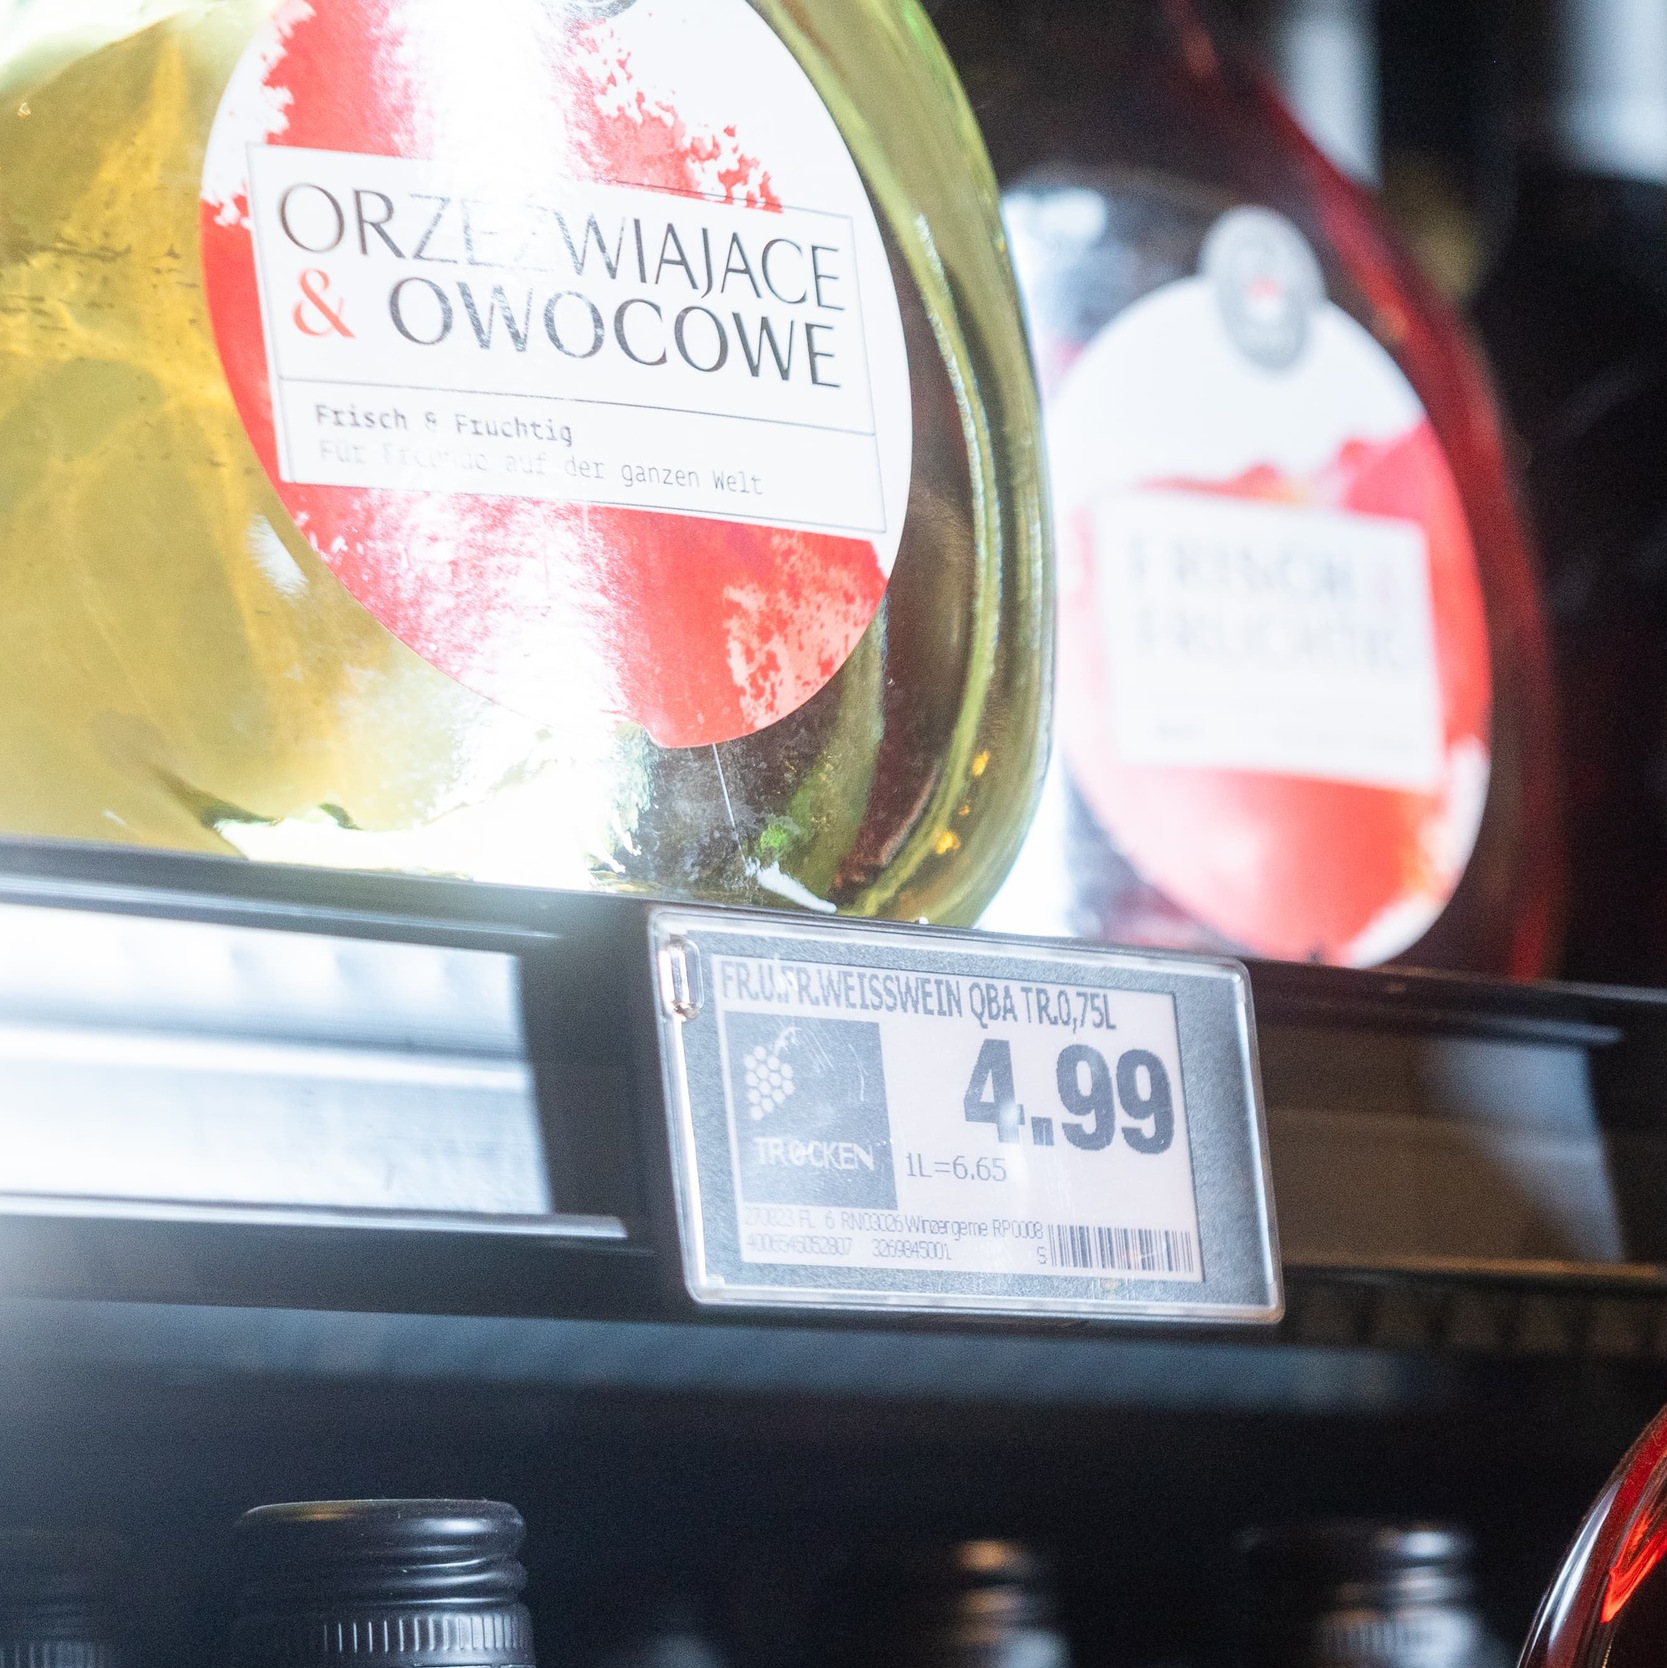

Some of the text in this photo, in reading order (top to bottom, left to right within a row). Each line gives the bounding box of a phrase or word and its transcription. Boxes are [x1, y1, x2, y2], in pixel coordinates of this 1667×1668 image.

[291, 268, 841, 388] & OWOCOWE
[315, 404, 407, 430] Frisch
[455, 414, 573, 447] Fruchtig
[504, 452, 547, 478] auf
[563, 455, 604, 481] der
[620, 462, 699, 490] ganzen
[711, 469, 763, 496] Welt
[969, 981, 1018, 1029] QBA
[963, 1039, 1175, 1156] 4.99
[753, 1136, 875, 1172] TROCKEN
[906, 1151, 1008, 1182] 1L=6.65
